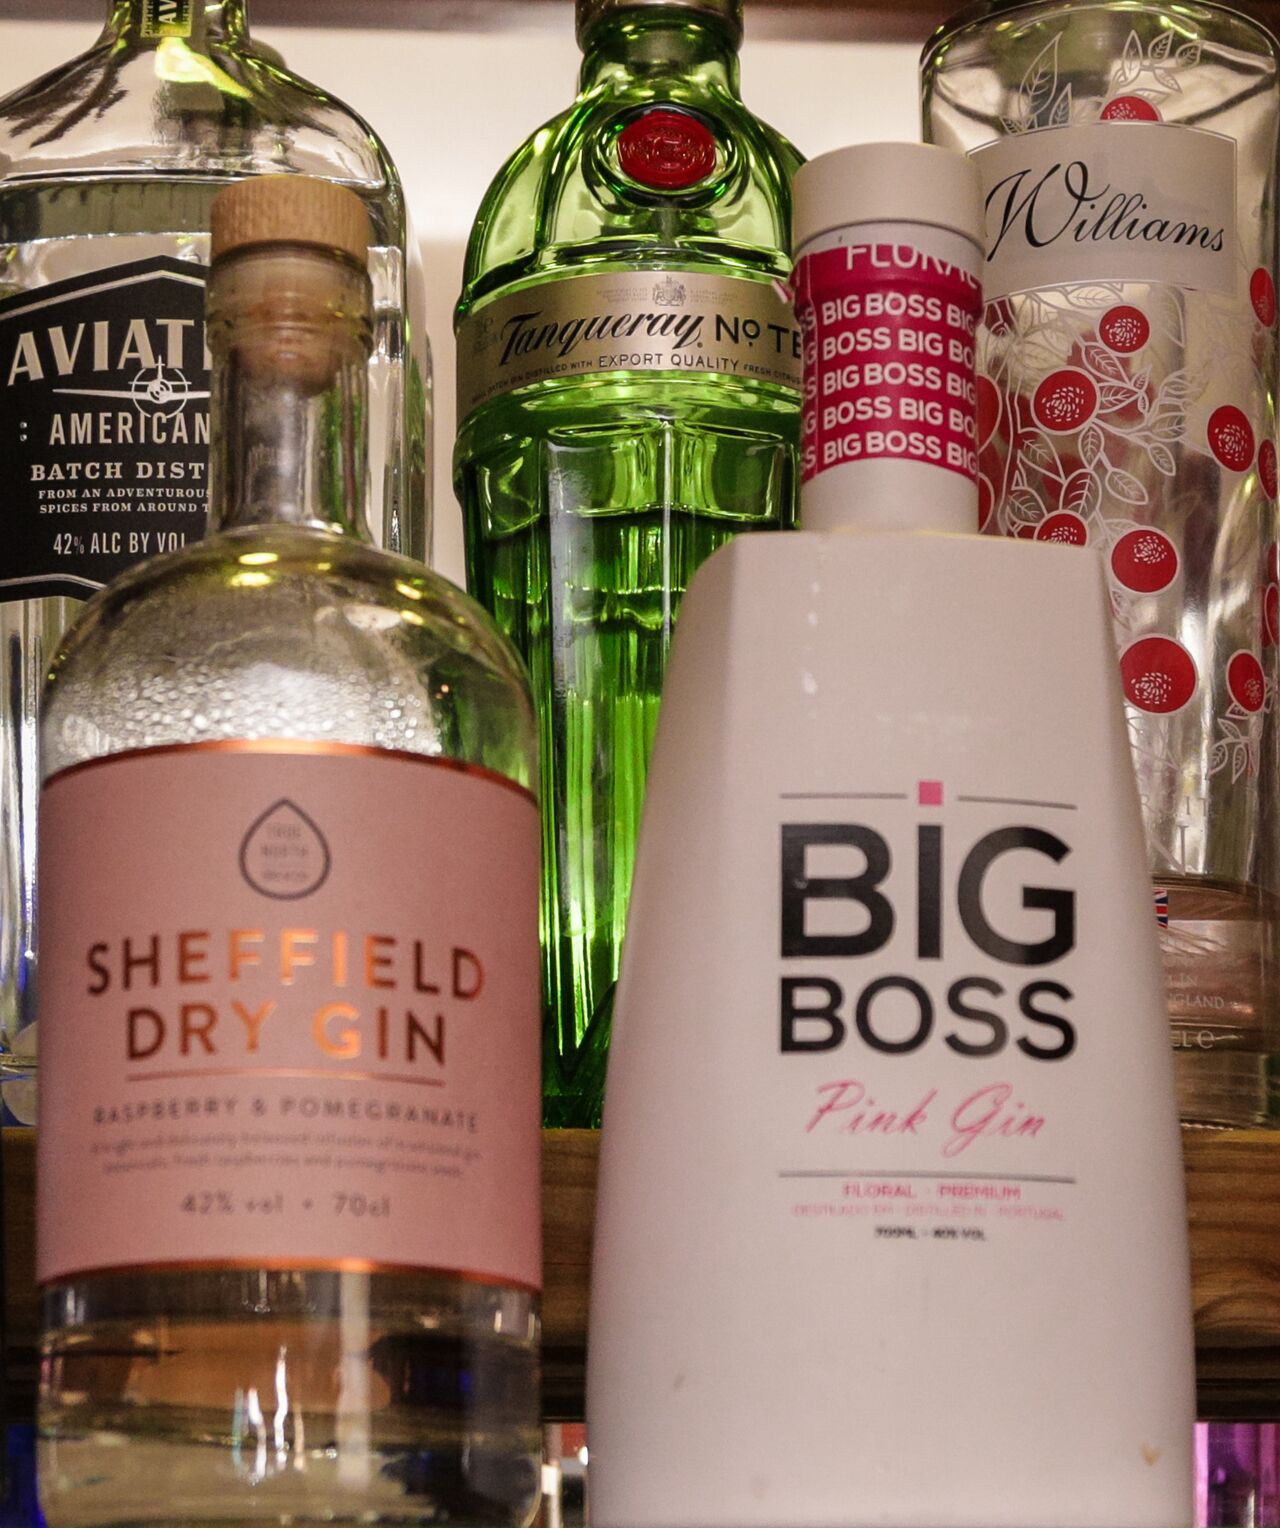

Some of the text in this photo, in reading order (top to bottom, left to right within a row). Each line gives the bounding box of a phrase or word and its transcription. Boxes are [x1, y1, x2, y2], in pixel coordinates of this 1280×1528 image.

[984, 160, 1225, 262] Williams
[822, 294, 861, 326] BIG
[865, 291, 942, 321] BOSS
[498, 310, 706, 367] Tanqueray
[823, 327, 892, 361] BOSS
[898, 328, 943, 356] BIG
[525, 363, 568, 381] DISTILLED
[570, 360, 593, 370] WITH
[598, 353, 663, 368] EXPORT
[670, 354, 739, 371] QUALITY
[743, 363, 771, 376] FRESH
[823, 365, 860, 396] BIG
[864, 362, 942, 390] BOSS
[947, 372, 976, 406] BIG
[48, 411, 211, 446] AMERICAN
[823, 396, 893, 430] BOSS
[898, 398, 943, 426] BIG
[823, 433, 862, 464] BIG
[865, 430, 942, 459] BOSS
[947, 442, 977, 474] BIG
[30, 462, 124, 481] BATCH
[38, 488, 77, 499] FROM
[81, 488, 101, 498] AN
[39, 503, 88, 514] SPICES
[92, 502, 132, 513] FROM
[136, 502, 197, 513] AROUND
[53, 533, 85, 555] 42%
[90, 532, 120, 554] ALC
[129, 532, 149, 554] BY
[779, 822, 1077, 966] BIG
[86, 928, 485, 1000] SHEFFIELD
[126, 1001, 446, 1066] DRY GIN
[779, 975, 1078, 1061] BOSS
[92, 1095, 480, 1135] RASPBERRY & POMEGRANATE
[804, 1079, 1046, 1158] Pink Gin
[180, 1190, 391, 1219] 42% vol 70cl
[843, 1183, 1022, 1199] FLORAL PREMIUM
